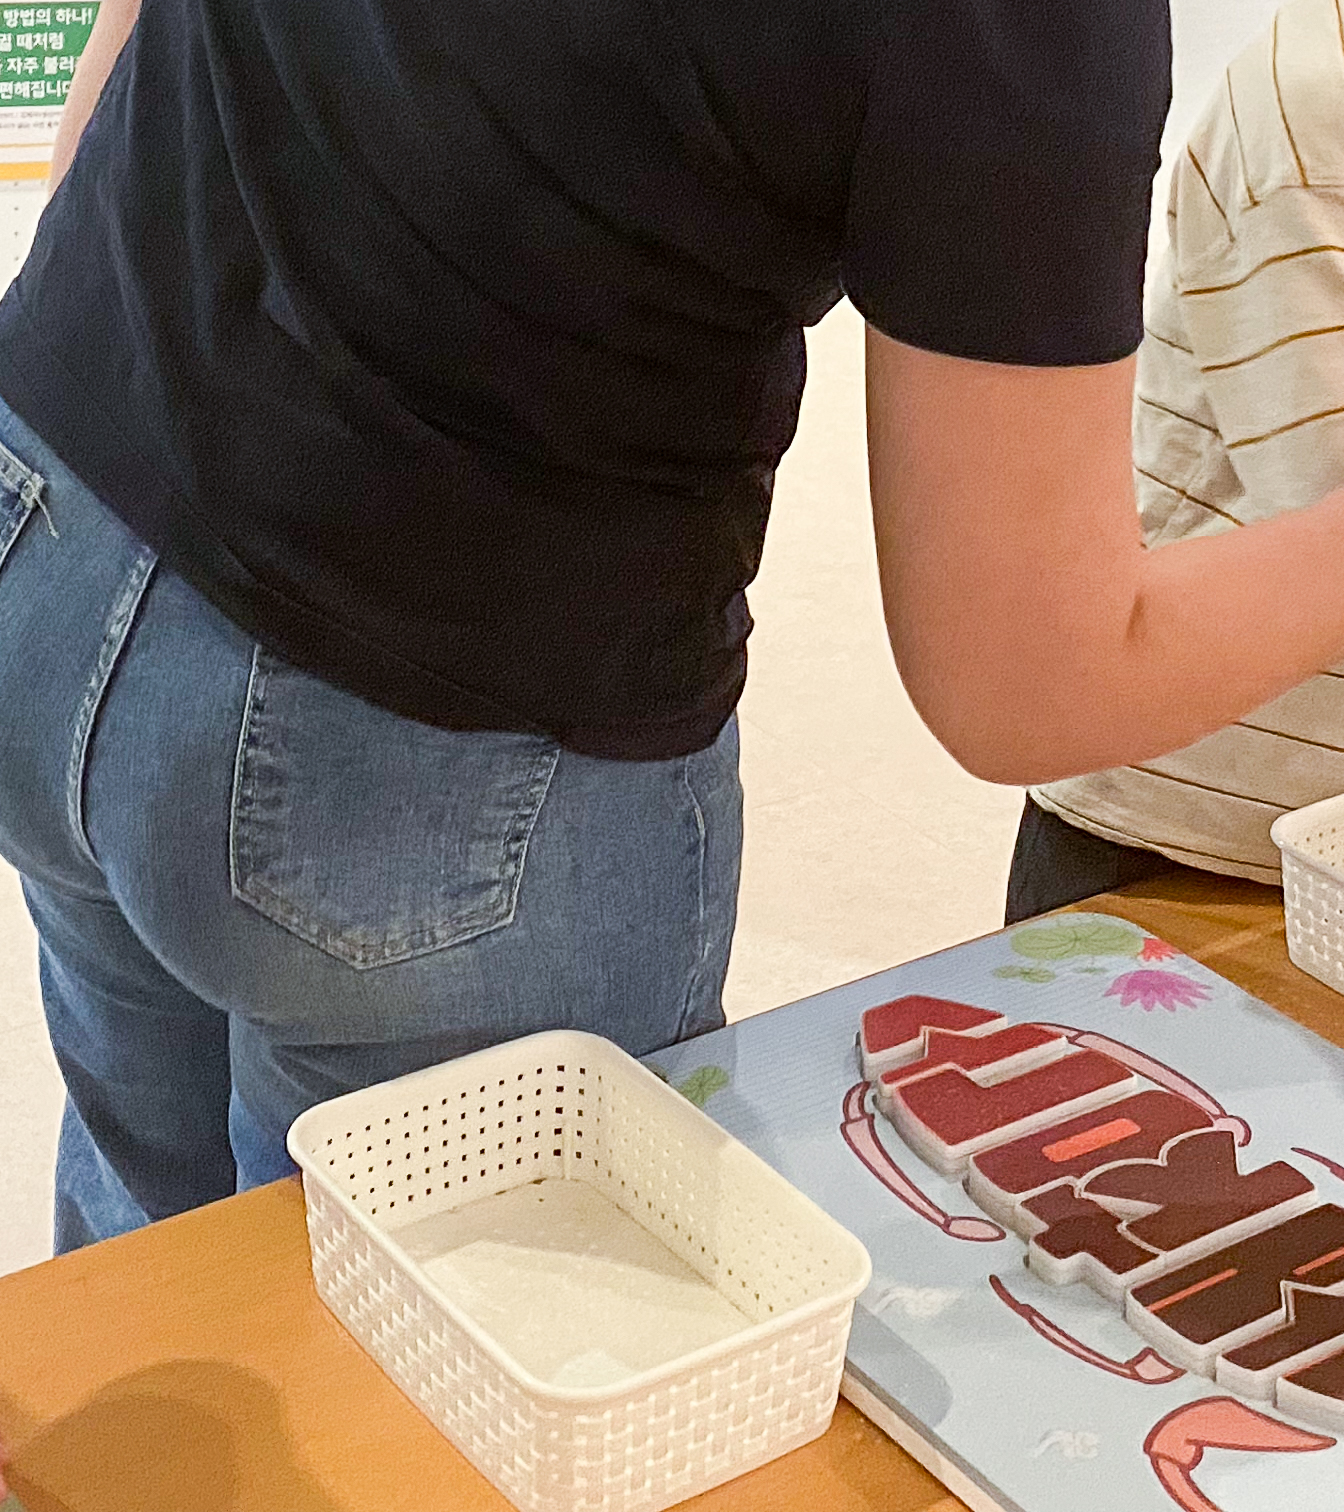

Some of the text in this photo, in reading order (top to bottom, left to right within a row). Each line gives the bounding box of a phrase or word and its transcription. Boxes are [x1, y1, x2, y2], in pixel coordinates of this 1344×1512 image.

[3, 8, 52, 28] 방법의
[55, 7, 93, 27] 하나!
[16, 32, 65, 52] 때처럼
[6, 57, 38, 76] 자주
[43, 56, 79, 76] 불러
